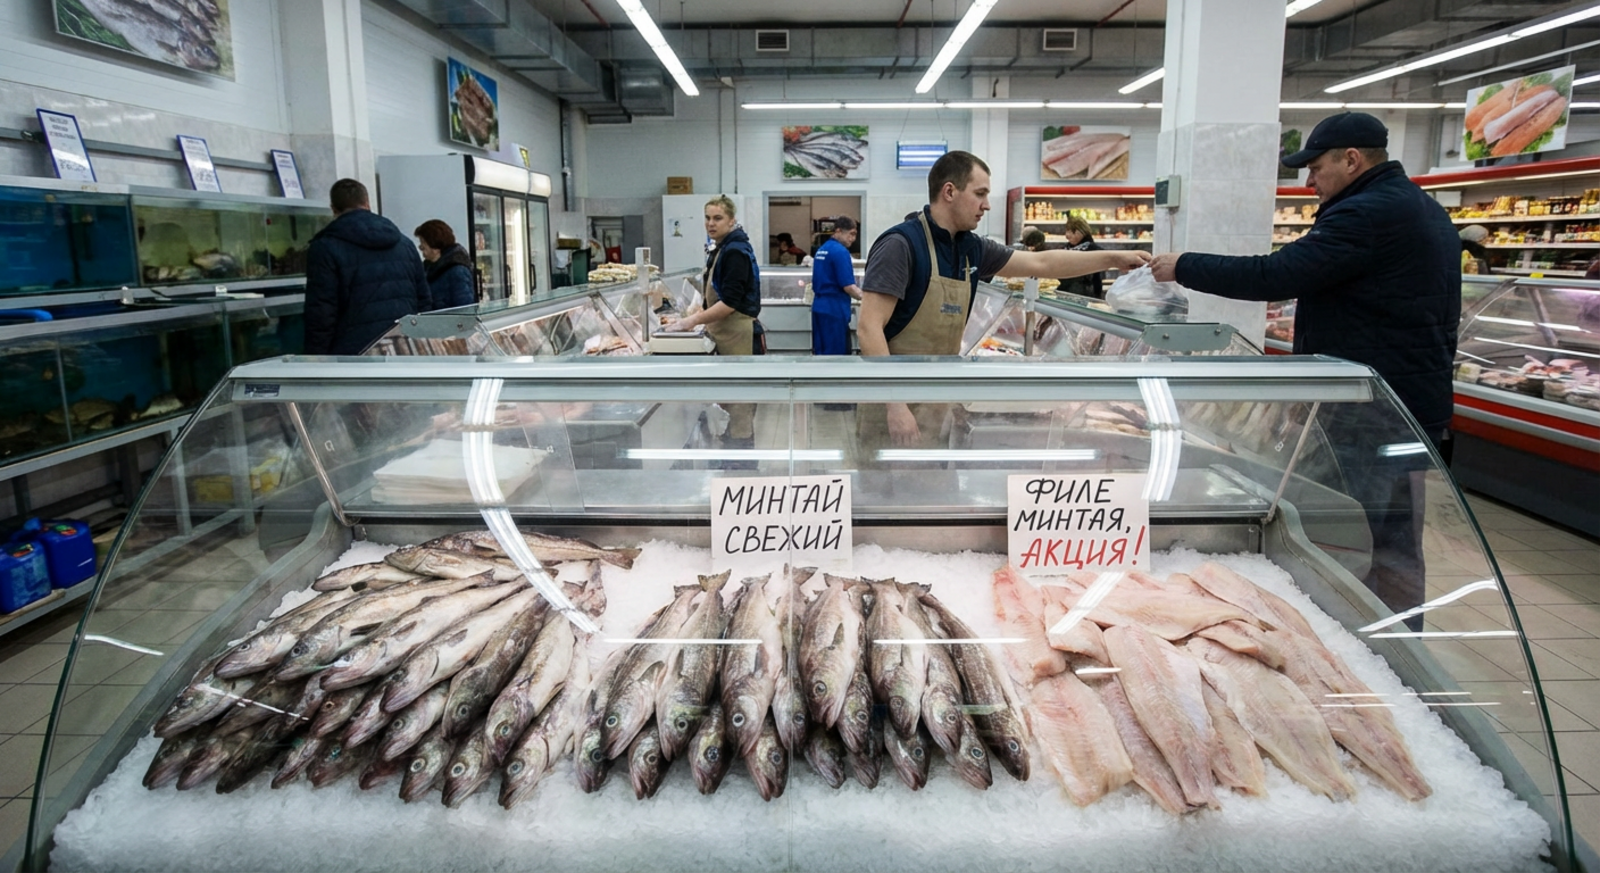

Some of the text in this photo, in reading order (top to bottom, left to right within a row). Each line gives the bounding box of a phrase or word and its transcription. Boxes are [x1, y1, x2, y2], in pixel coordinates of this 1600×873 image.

[719, 479, 844, 516] МИНТАЙ
[1025, 478, 1115, 505] ФИЛЕ
[724, 519, 843, 554] СВЕЖИЙ
[1013, 508, 1132, 534] МИНТАЯ,
[1020, 526, 1146, 570] АКЦИЯ!
